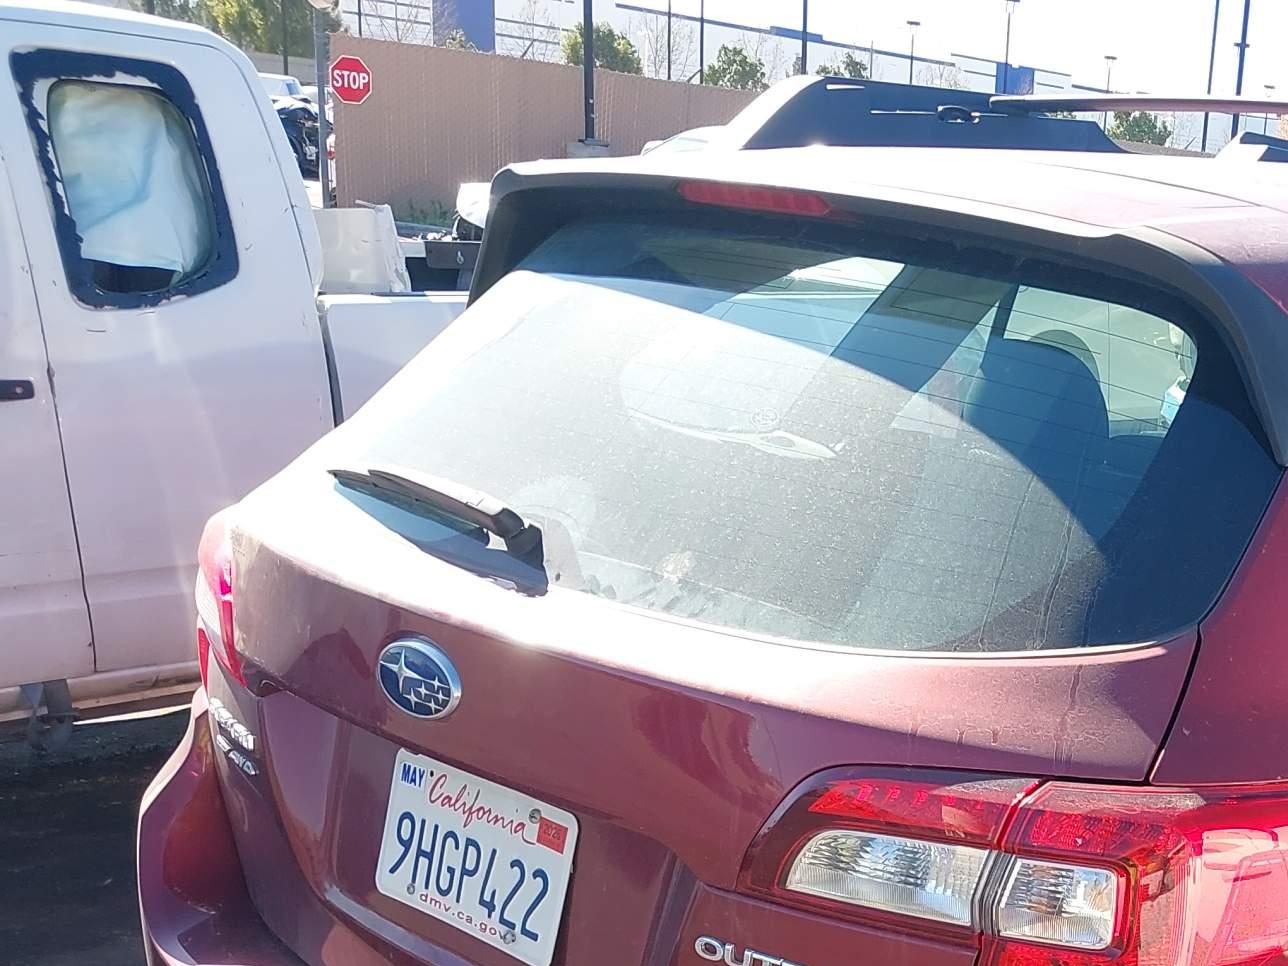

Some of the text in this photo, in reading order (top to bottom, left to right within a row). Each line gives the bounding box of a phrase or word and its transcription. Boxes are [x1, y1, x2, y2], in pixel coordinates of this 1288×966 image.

[333, 69, 369, 90] STOP
[401, 762, 426, 788] MAY
[429, 773, 537, 845] California
[388, 811, 549, 942] 9HGP422
